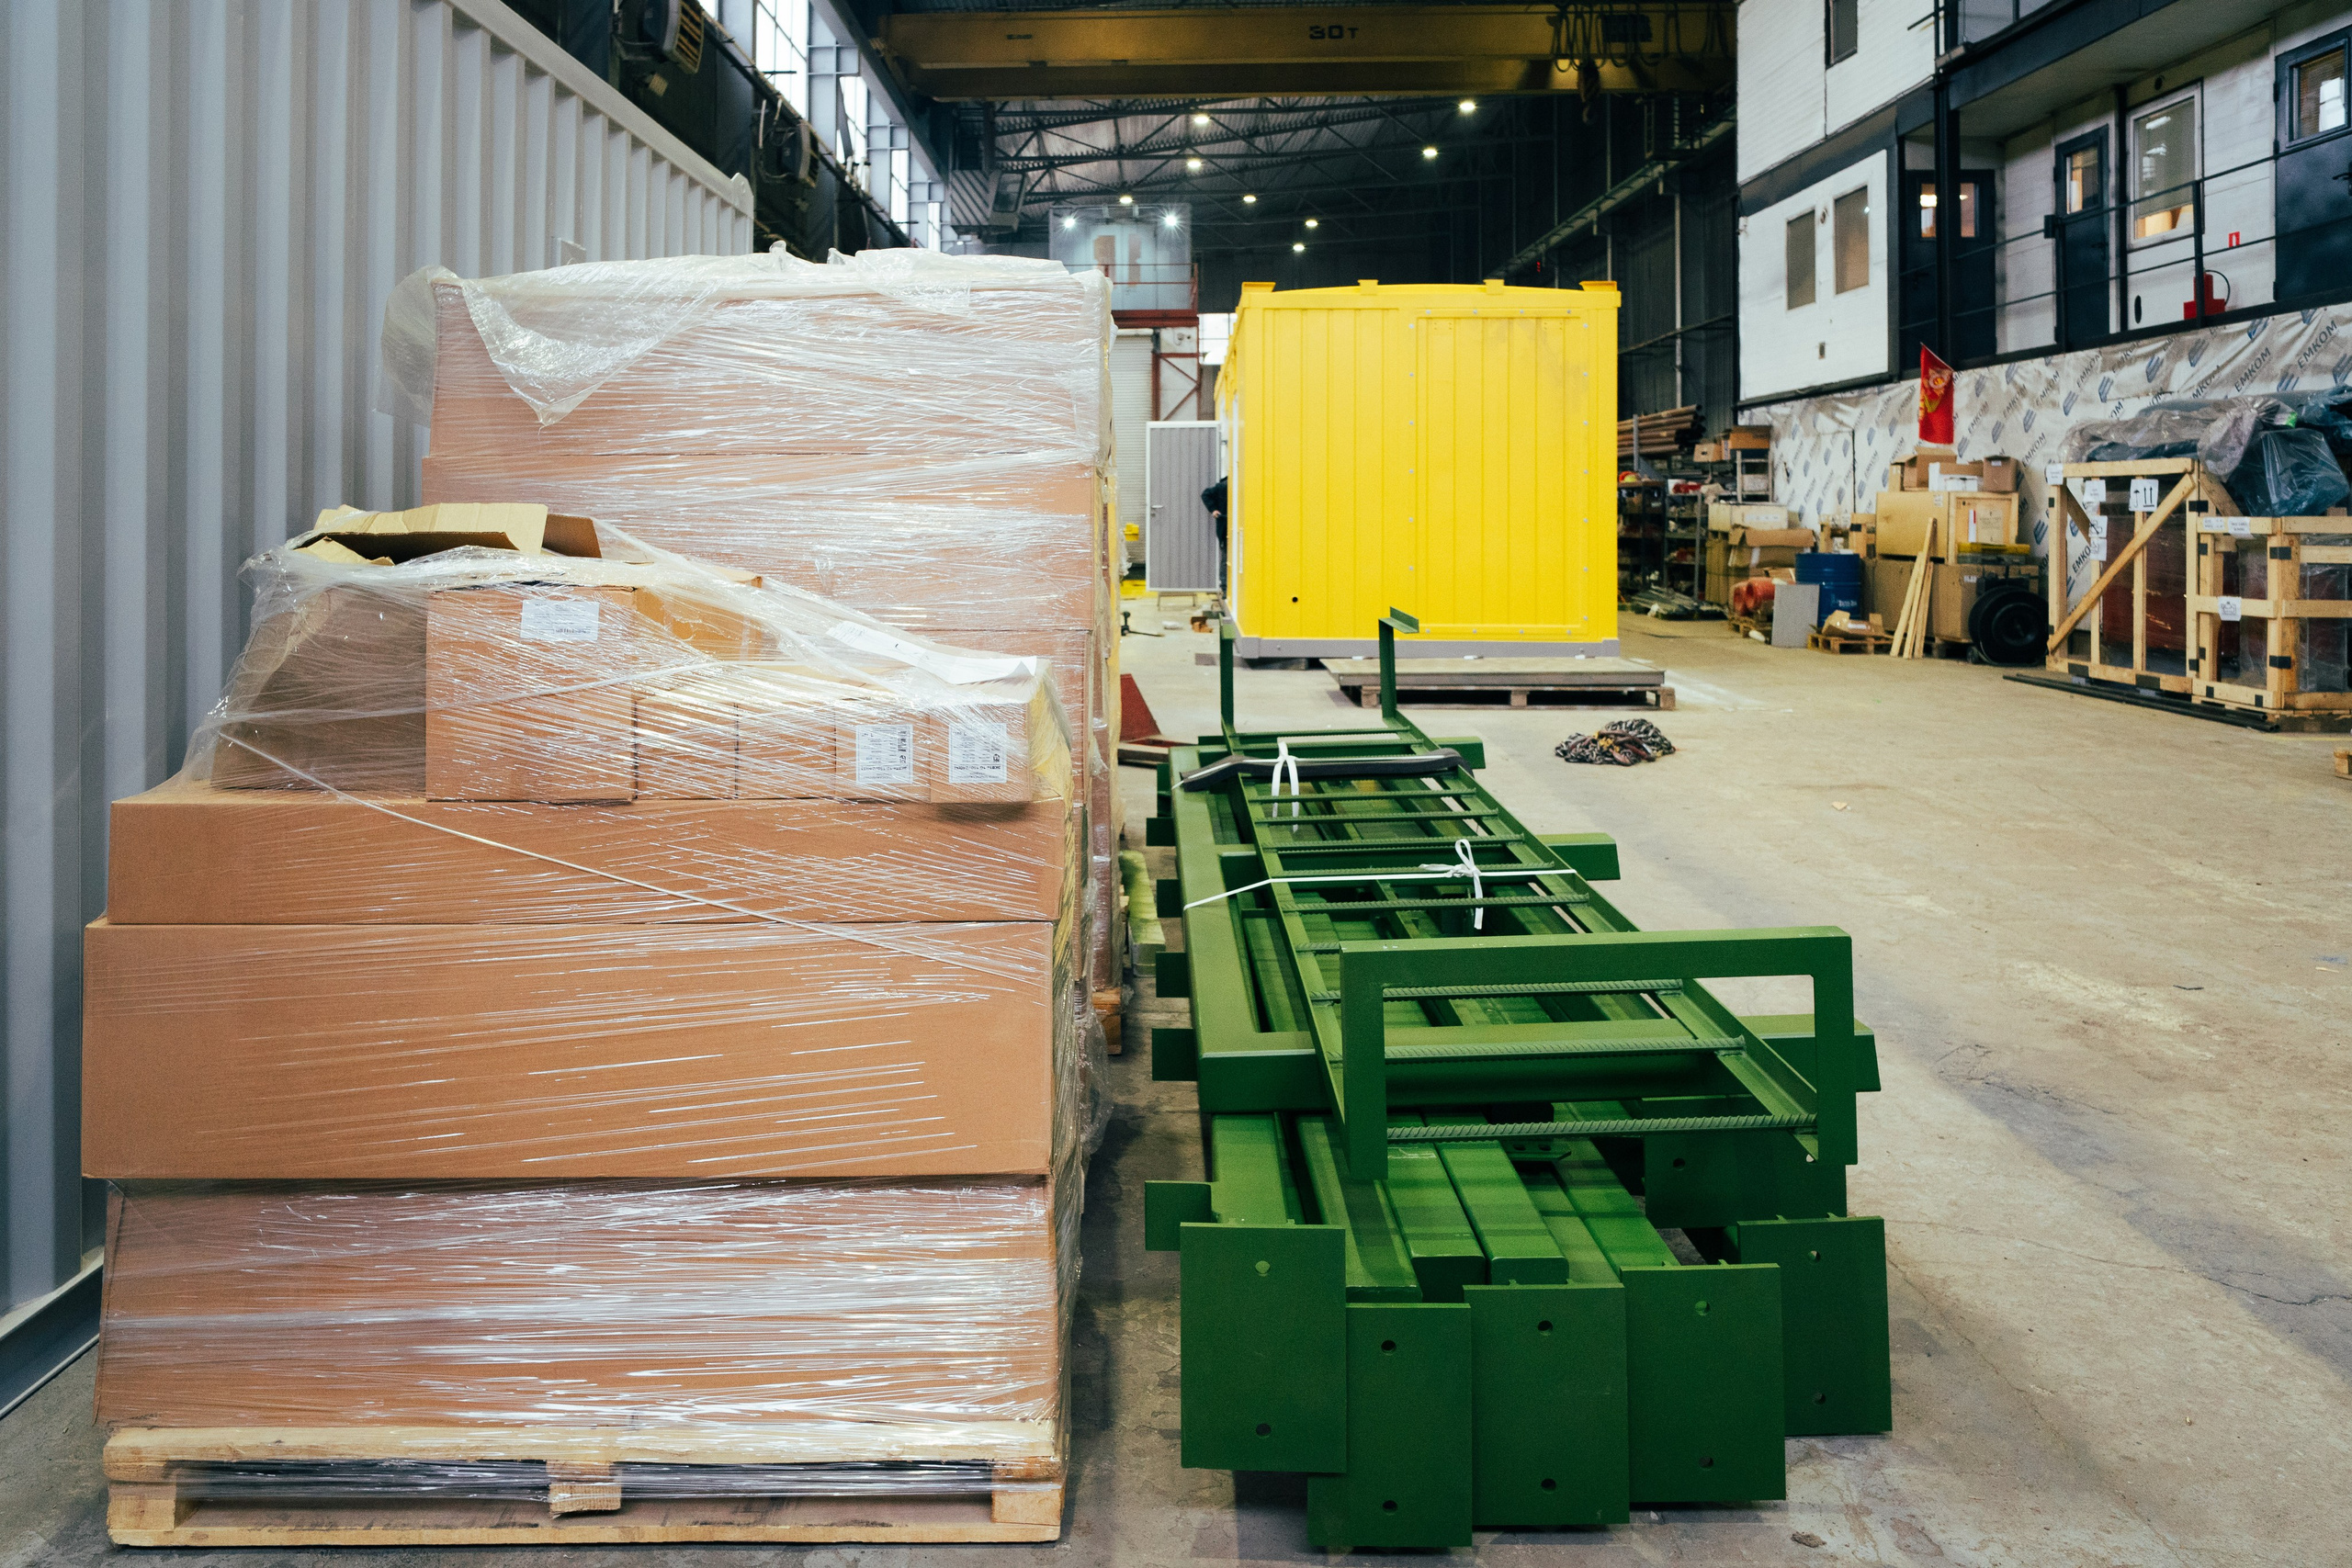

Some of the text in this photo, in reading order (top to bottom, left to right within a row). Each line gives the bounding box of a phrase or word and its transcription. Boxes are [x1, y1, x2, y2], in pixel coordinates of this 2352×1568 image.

[2298, 320, 2337, 369] EMKOM
[2233, 347, 2271, 392] EMKOM
[2073, 546, 2091, 573] EMKO
